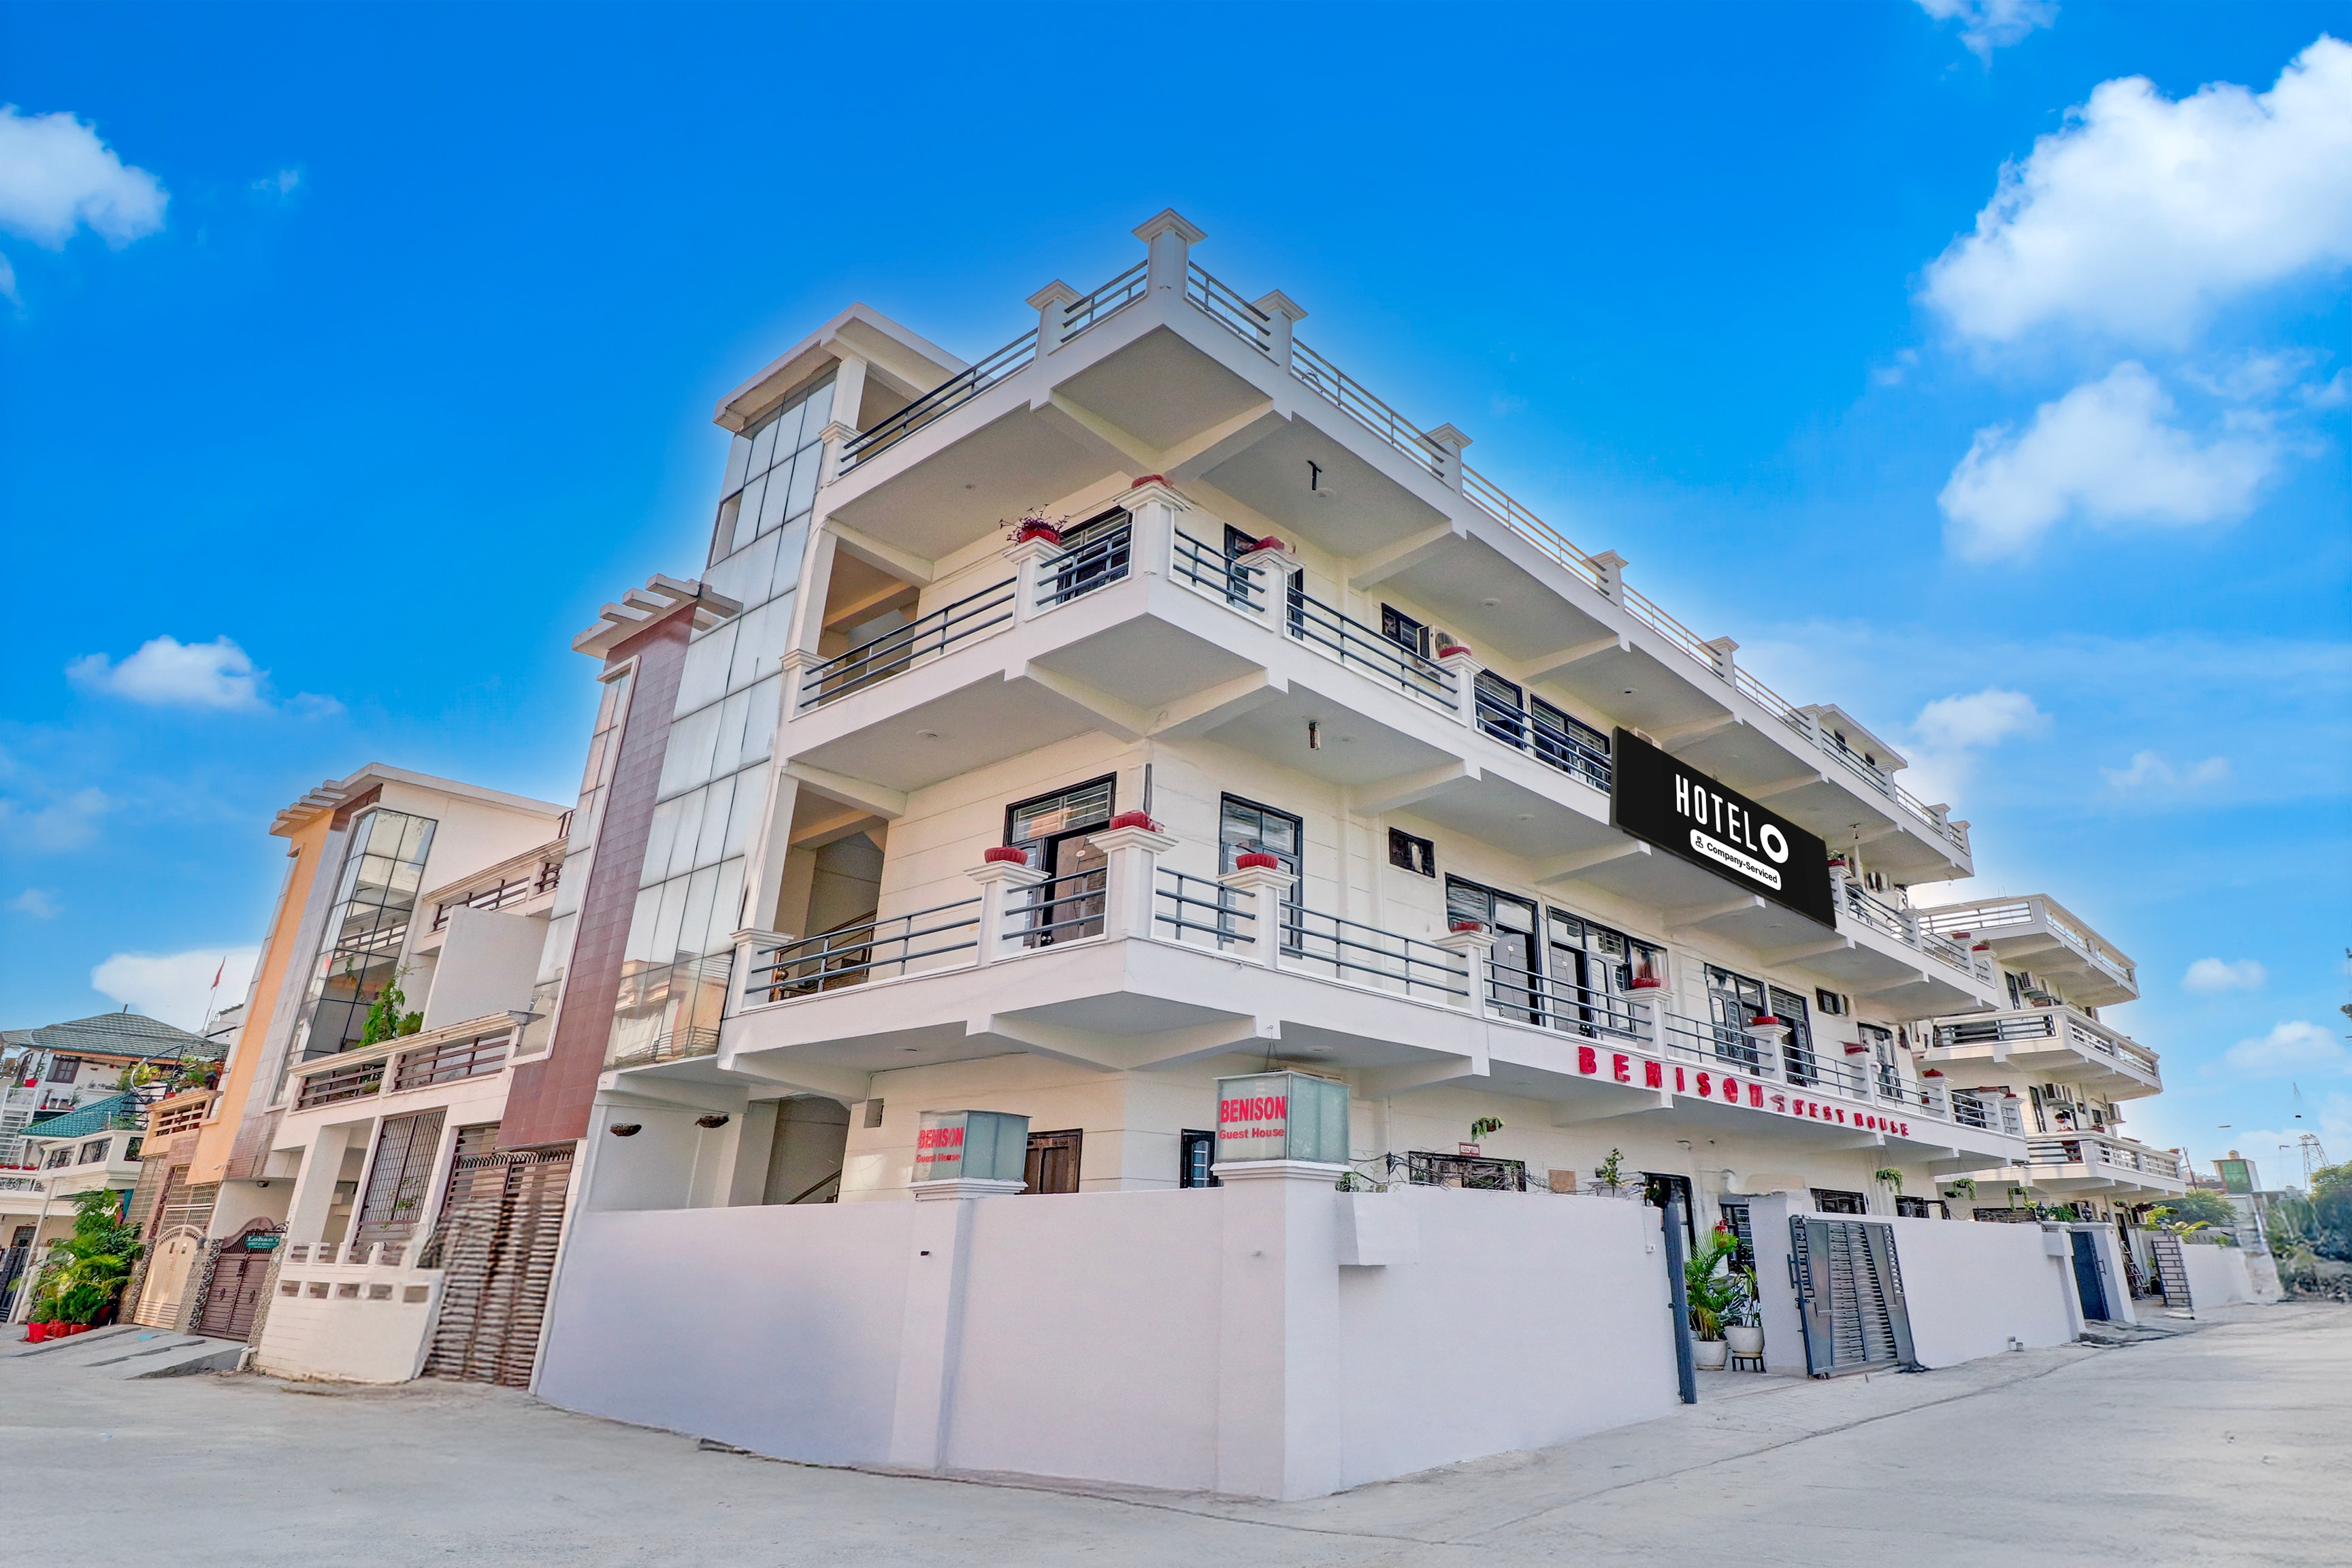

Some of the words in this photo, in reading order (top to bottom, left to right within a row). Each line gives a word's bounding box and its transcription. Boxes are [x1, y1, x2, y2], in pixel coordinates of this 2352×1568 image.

[1676, 773, 1758, 852] HOTEL
[1760, 823, 1789, 864] O
[1707, 843, 1778, 883] Company-Serviced
[1578, 1046, 1764, 1108] BENISON
[1853, 1112, 1910, 1137] HOUSE
[1220, 1096, 1286, 1123] BENISON
[918, 1127, 964, 1149] BENISON
[1218, 1128, 1248, 1140] Guest
[1252, 1128, 1285, 1139] House
[916, 1154, 936, 1163] Guest
[938, 1154, 960, 1162] House
